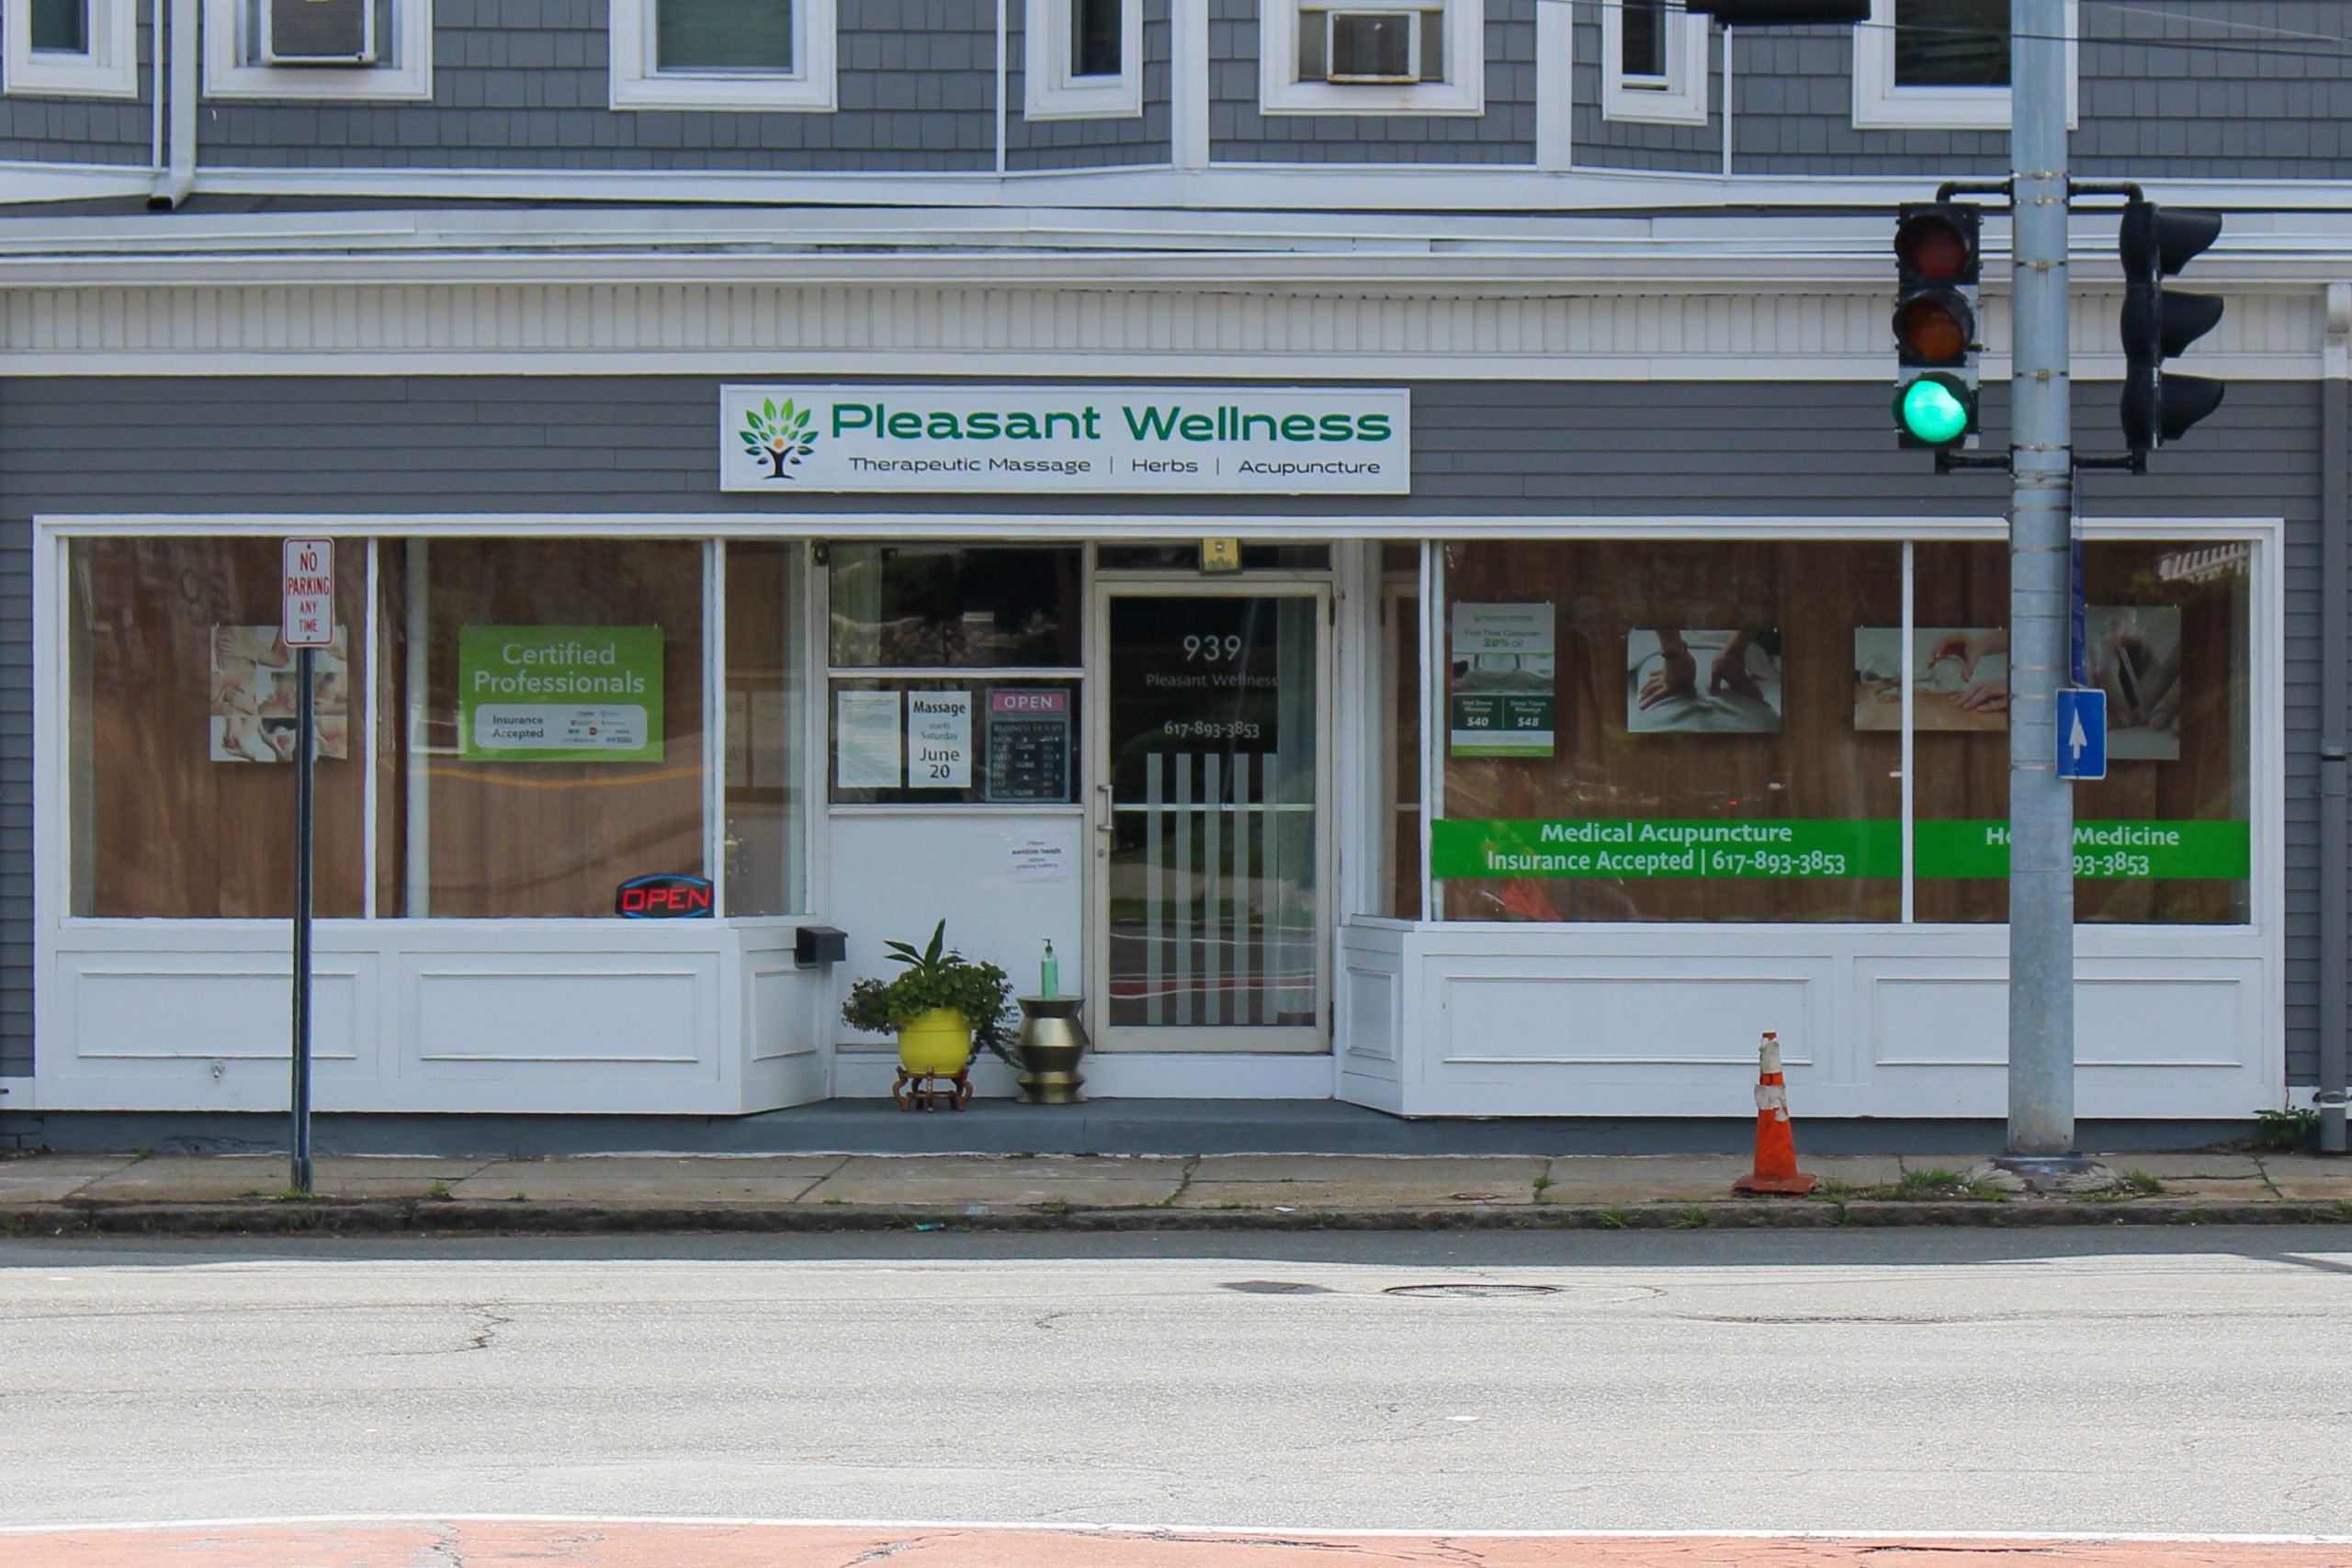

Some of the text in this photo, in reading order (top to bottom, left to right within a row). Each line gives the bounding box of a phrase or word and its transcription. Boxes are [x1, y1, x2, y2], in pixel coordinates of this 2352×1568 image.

[831, 402, 1392, 442] Pleasant Wellness
[848, 457, 1381, 476] Therapeutic Massage Herbs Acupuncture
[300, 551, 318, 571] NO
[288, 576, 330, 596] PARKING
[300, 600, 318, 615] ANY
[299, 618, 318, 633] TIME
[502, 642, 616, 666] Certified
[1182, 635, 1241, 661] 939
[473, 670, 646, 693] Professionals
[1146, 673, 1278, 687] Pleasant Wellness
[913, 701, 967, 716] Massage
[1004, 695, 1053, 708] OPEN
[492, 715, 544, 725] Insurance
[929, 722, 951, 730] starts
[1163, 720, 1260, 738] 617-893-3853
[492, 728, 544, 740] Accepted
[921, 730, 958, 740] Saturday
[920, 747, 960, 761] June
[930, 763, 950, 779] 20
[1540, 822, 1793, 846] Medical Acupuncture
[2073, 826, 2180, 846] Medicine
[1487, 850, 1846, 874] Insurance Accepted 617-893-3853
[2073, 852, 2150, 875] 93-3853
[622, 887, 712, 911] OPEN
